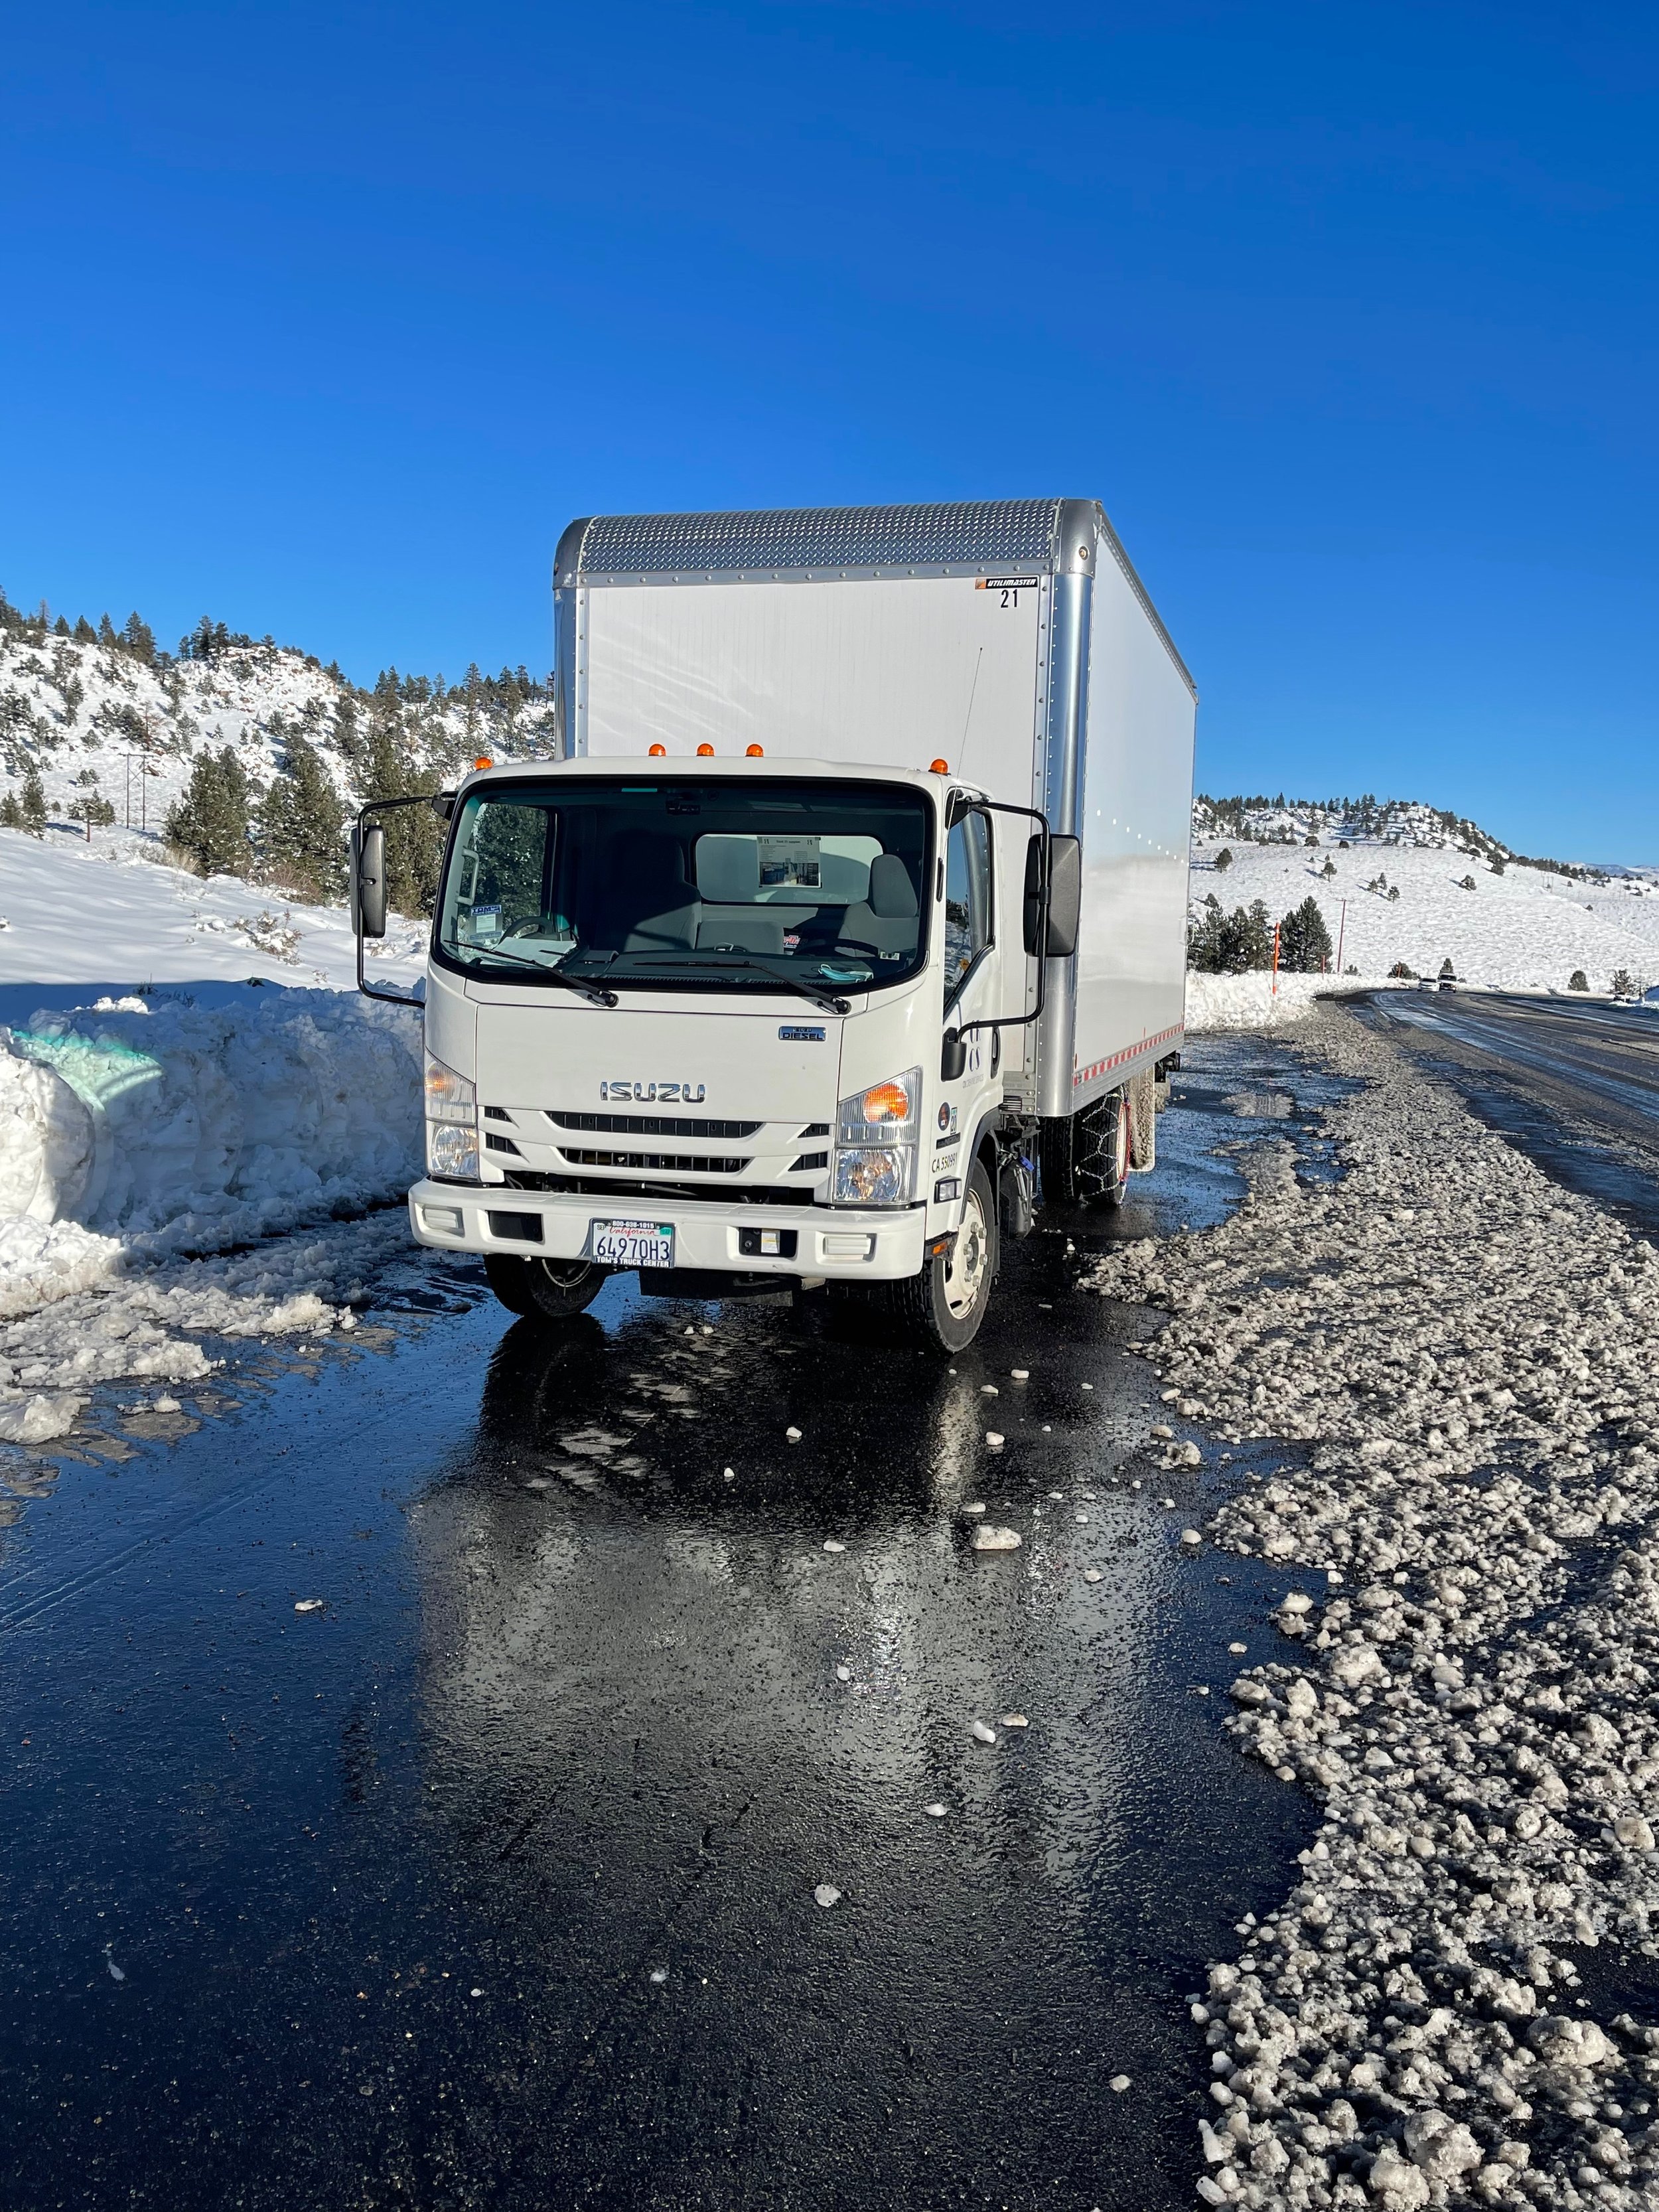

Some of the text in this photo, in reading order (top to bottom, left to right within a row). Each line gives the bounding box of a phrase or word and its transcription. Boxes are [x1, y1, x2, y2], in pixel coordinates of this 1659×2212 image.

[987, 578, 1037, 587] UTILIMASTER
[1001, 589, 1018, 608] 21
[969, 1047, 980, 1072] CS
[601, 1081, 706, 1103] ISUZU
[932, 1158, 940, 1173] CA
[610, 1226, 655, 1237] California
[597, 1236, 670, 1260] 64970H3
[643, 1259, 670, 1268] CENTER
